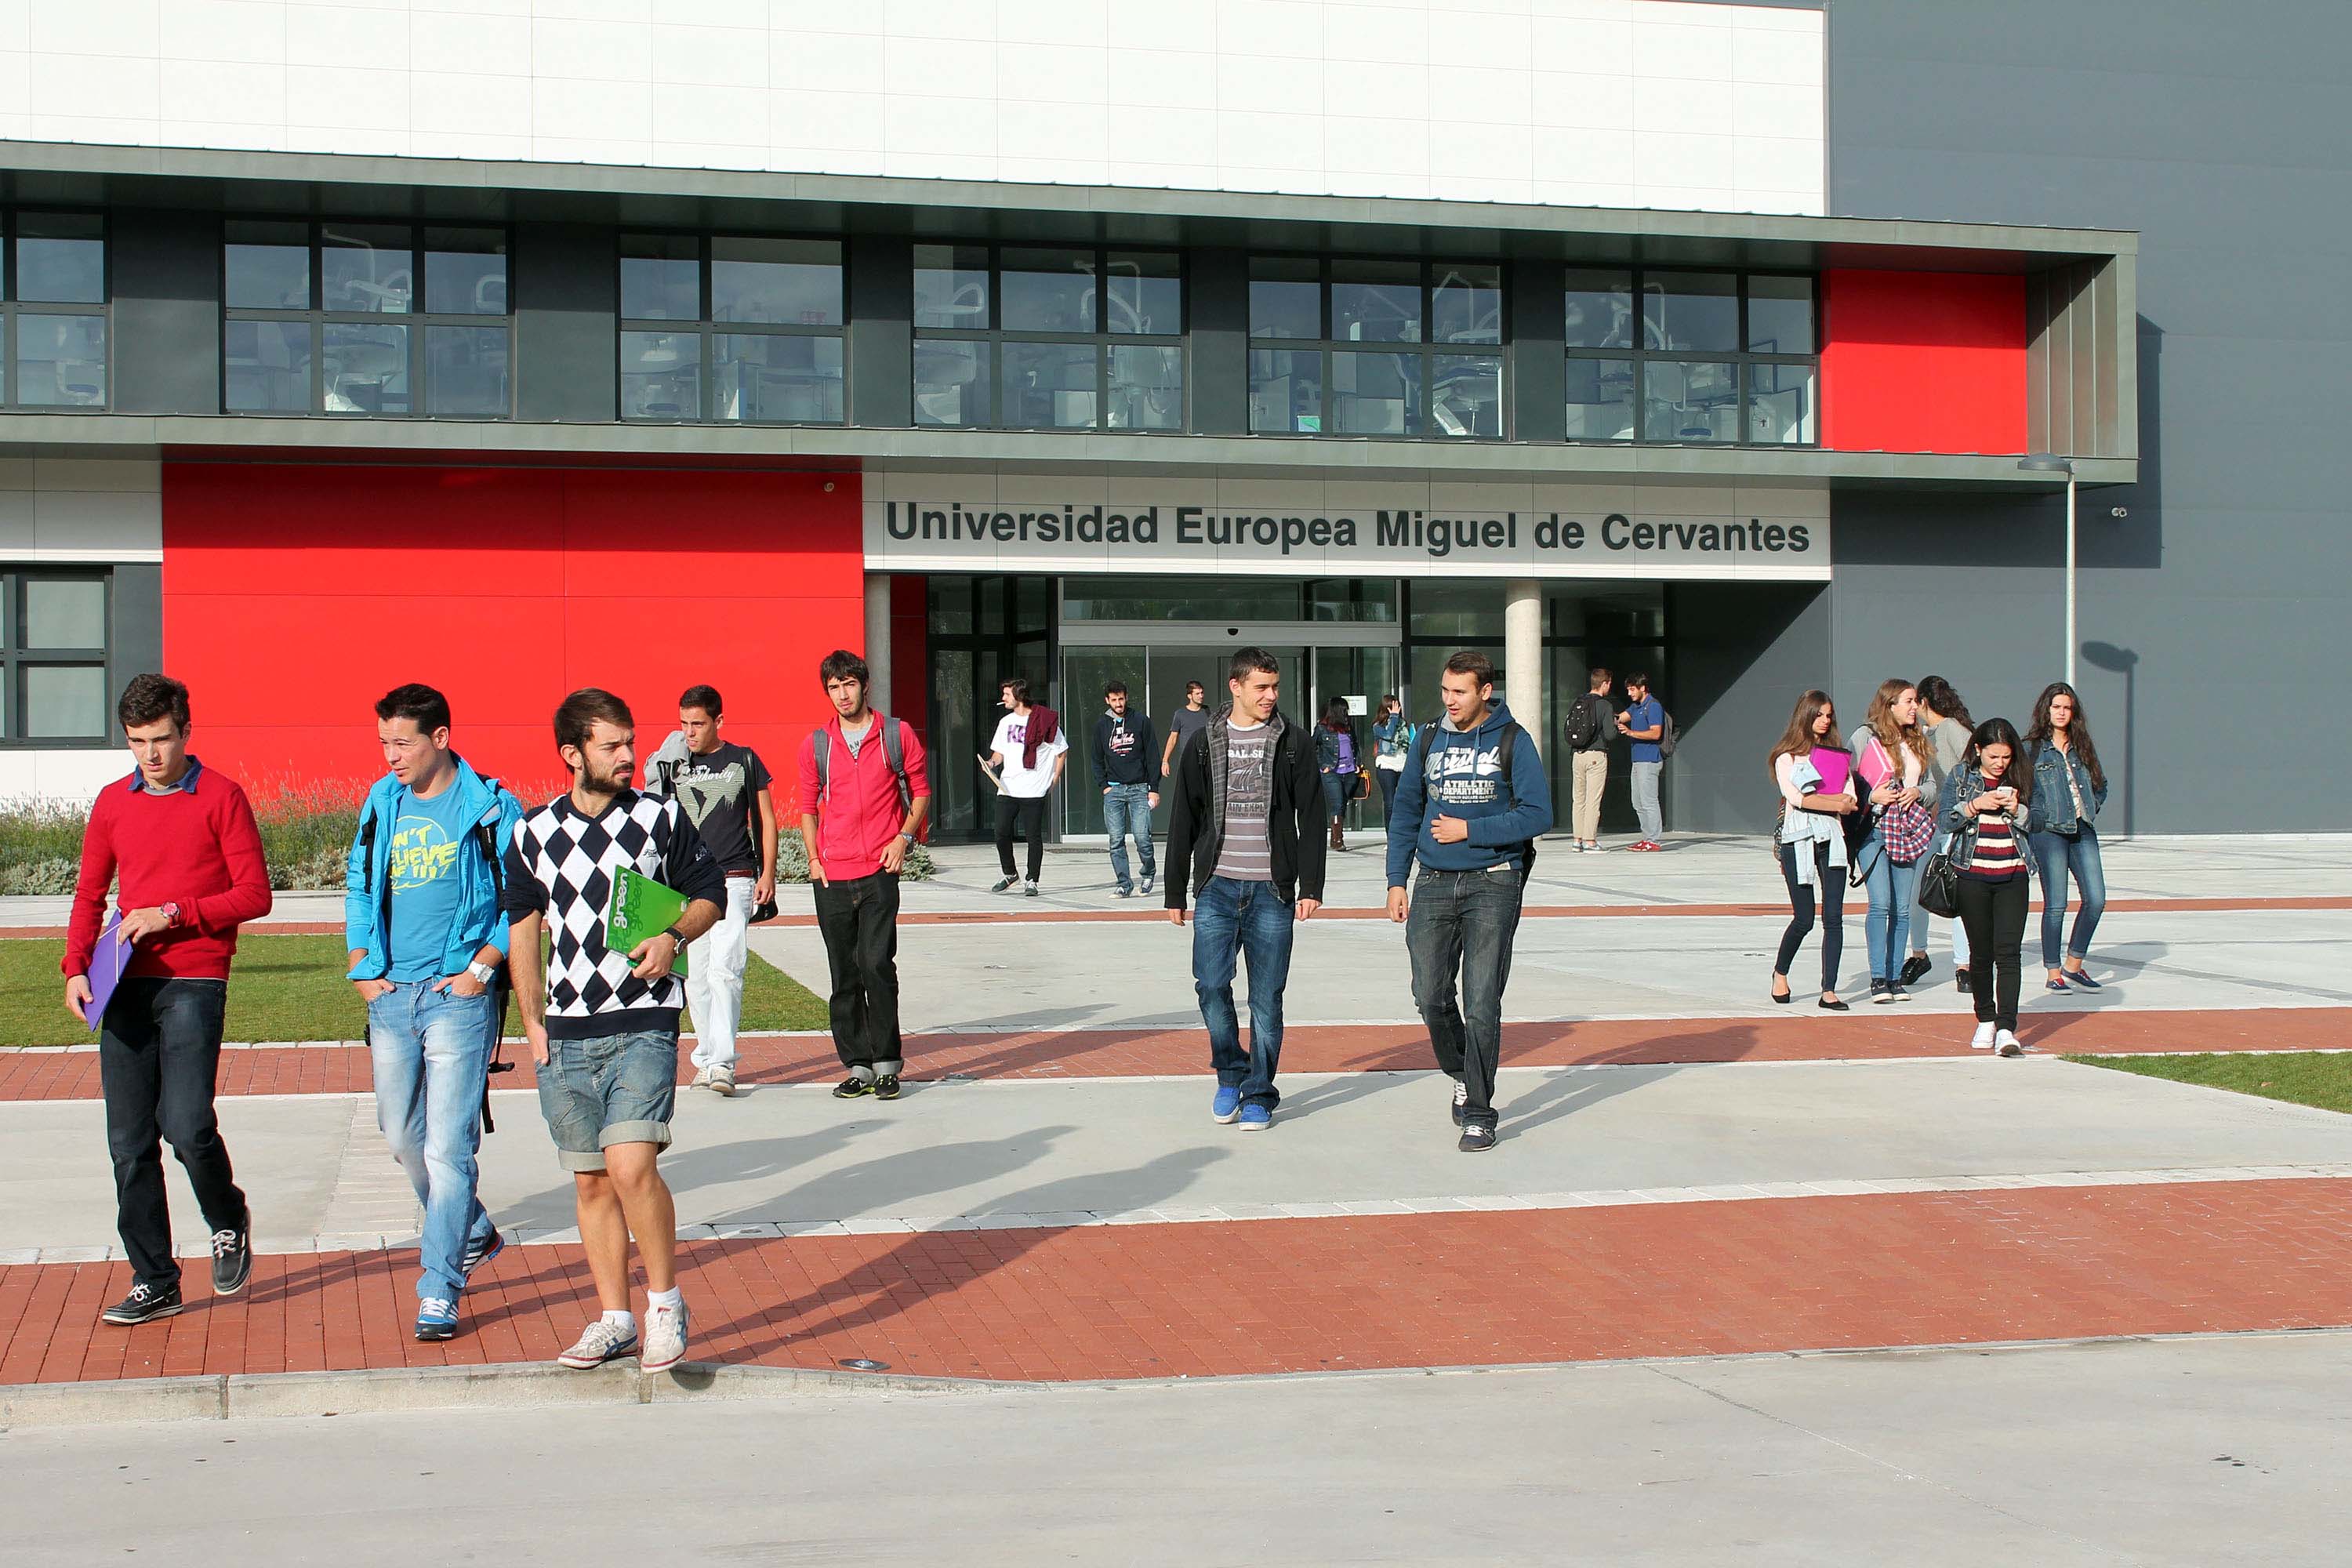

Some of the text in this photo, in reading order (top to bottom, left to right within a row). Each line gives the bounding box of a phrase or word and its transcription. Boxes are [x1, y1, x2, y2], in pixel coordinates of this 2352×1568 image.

[887, 501, 1809, 557] Universidad Europea Miguel de Cervantes
[1443, 787, 1495, 796] DEPARTMENT
[613, 872, 628, 930] green
